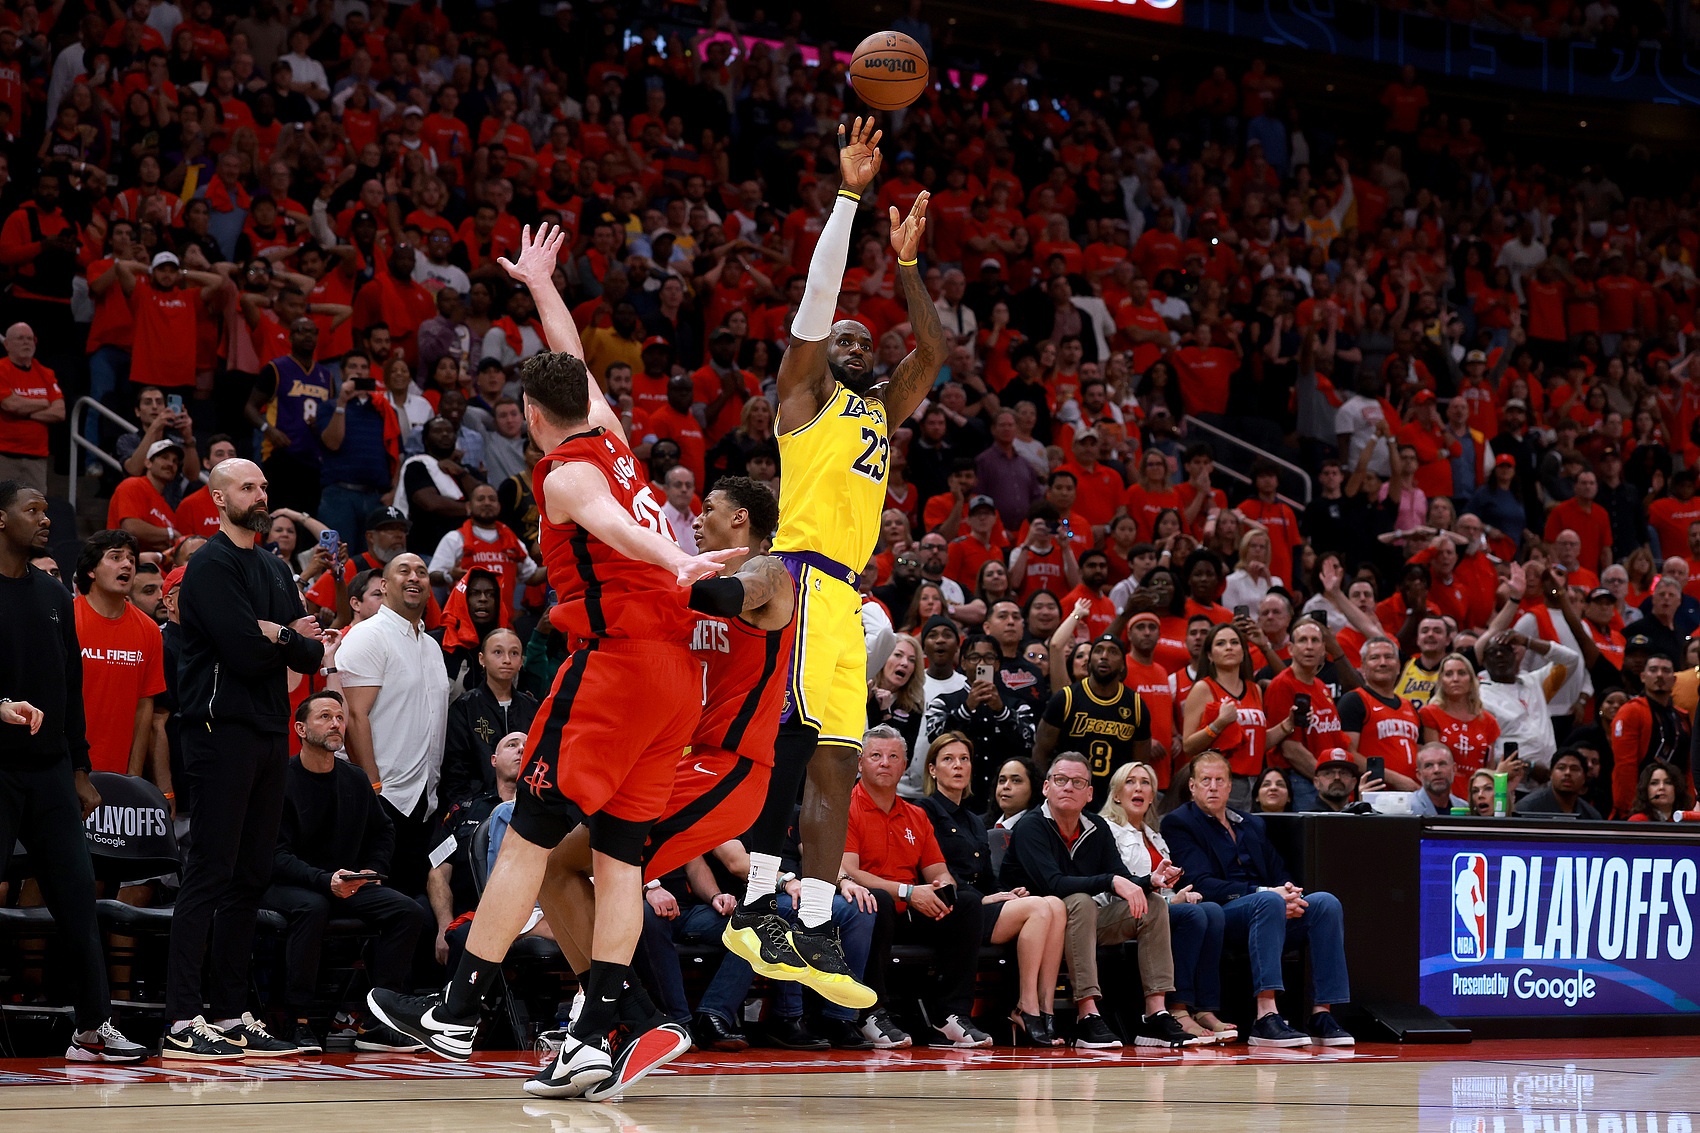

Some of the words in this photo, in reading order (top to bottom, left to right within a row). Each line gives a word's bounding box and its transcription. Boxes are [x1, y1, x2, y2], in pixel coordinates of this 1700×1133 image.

[865, 58, 917, 75] Wilson
[850, 425, 890, 485] 23
[81, 647, 105, 660] ALL
[106, 649, 137, 662] FIRE
[1069, 711, 1136, 741] LEGEND
[1089, 740, 1112, 777] 8
[1399, 738, 1413, 765] 7
[85, 805, 167, 837] PLAYOFFS
[93, 833, 126, 848] Google
[1493, 855, 1697, 961] PLAYOFFS
[1456, 936, 1474, 955] NBA
[1452, 972, 1497, 996] Presented
[1498, 972, 1509, 999] by
[1513, 967, 1597, 1007] Google
